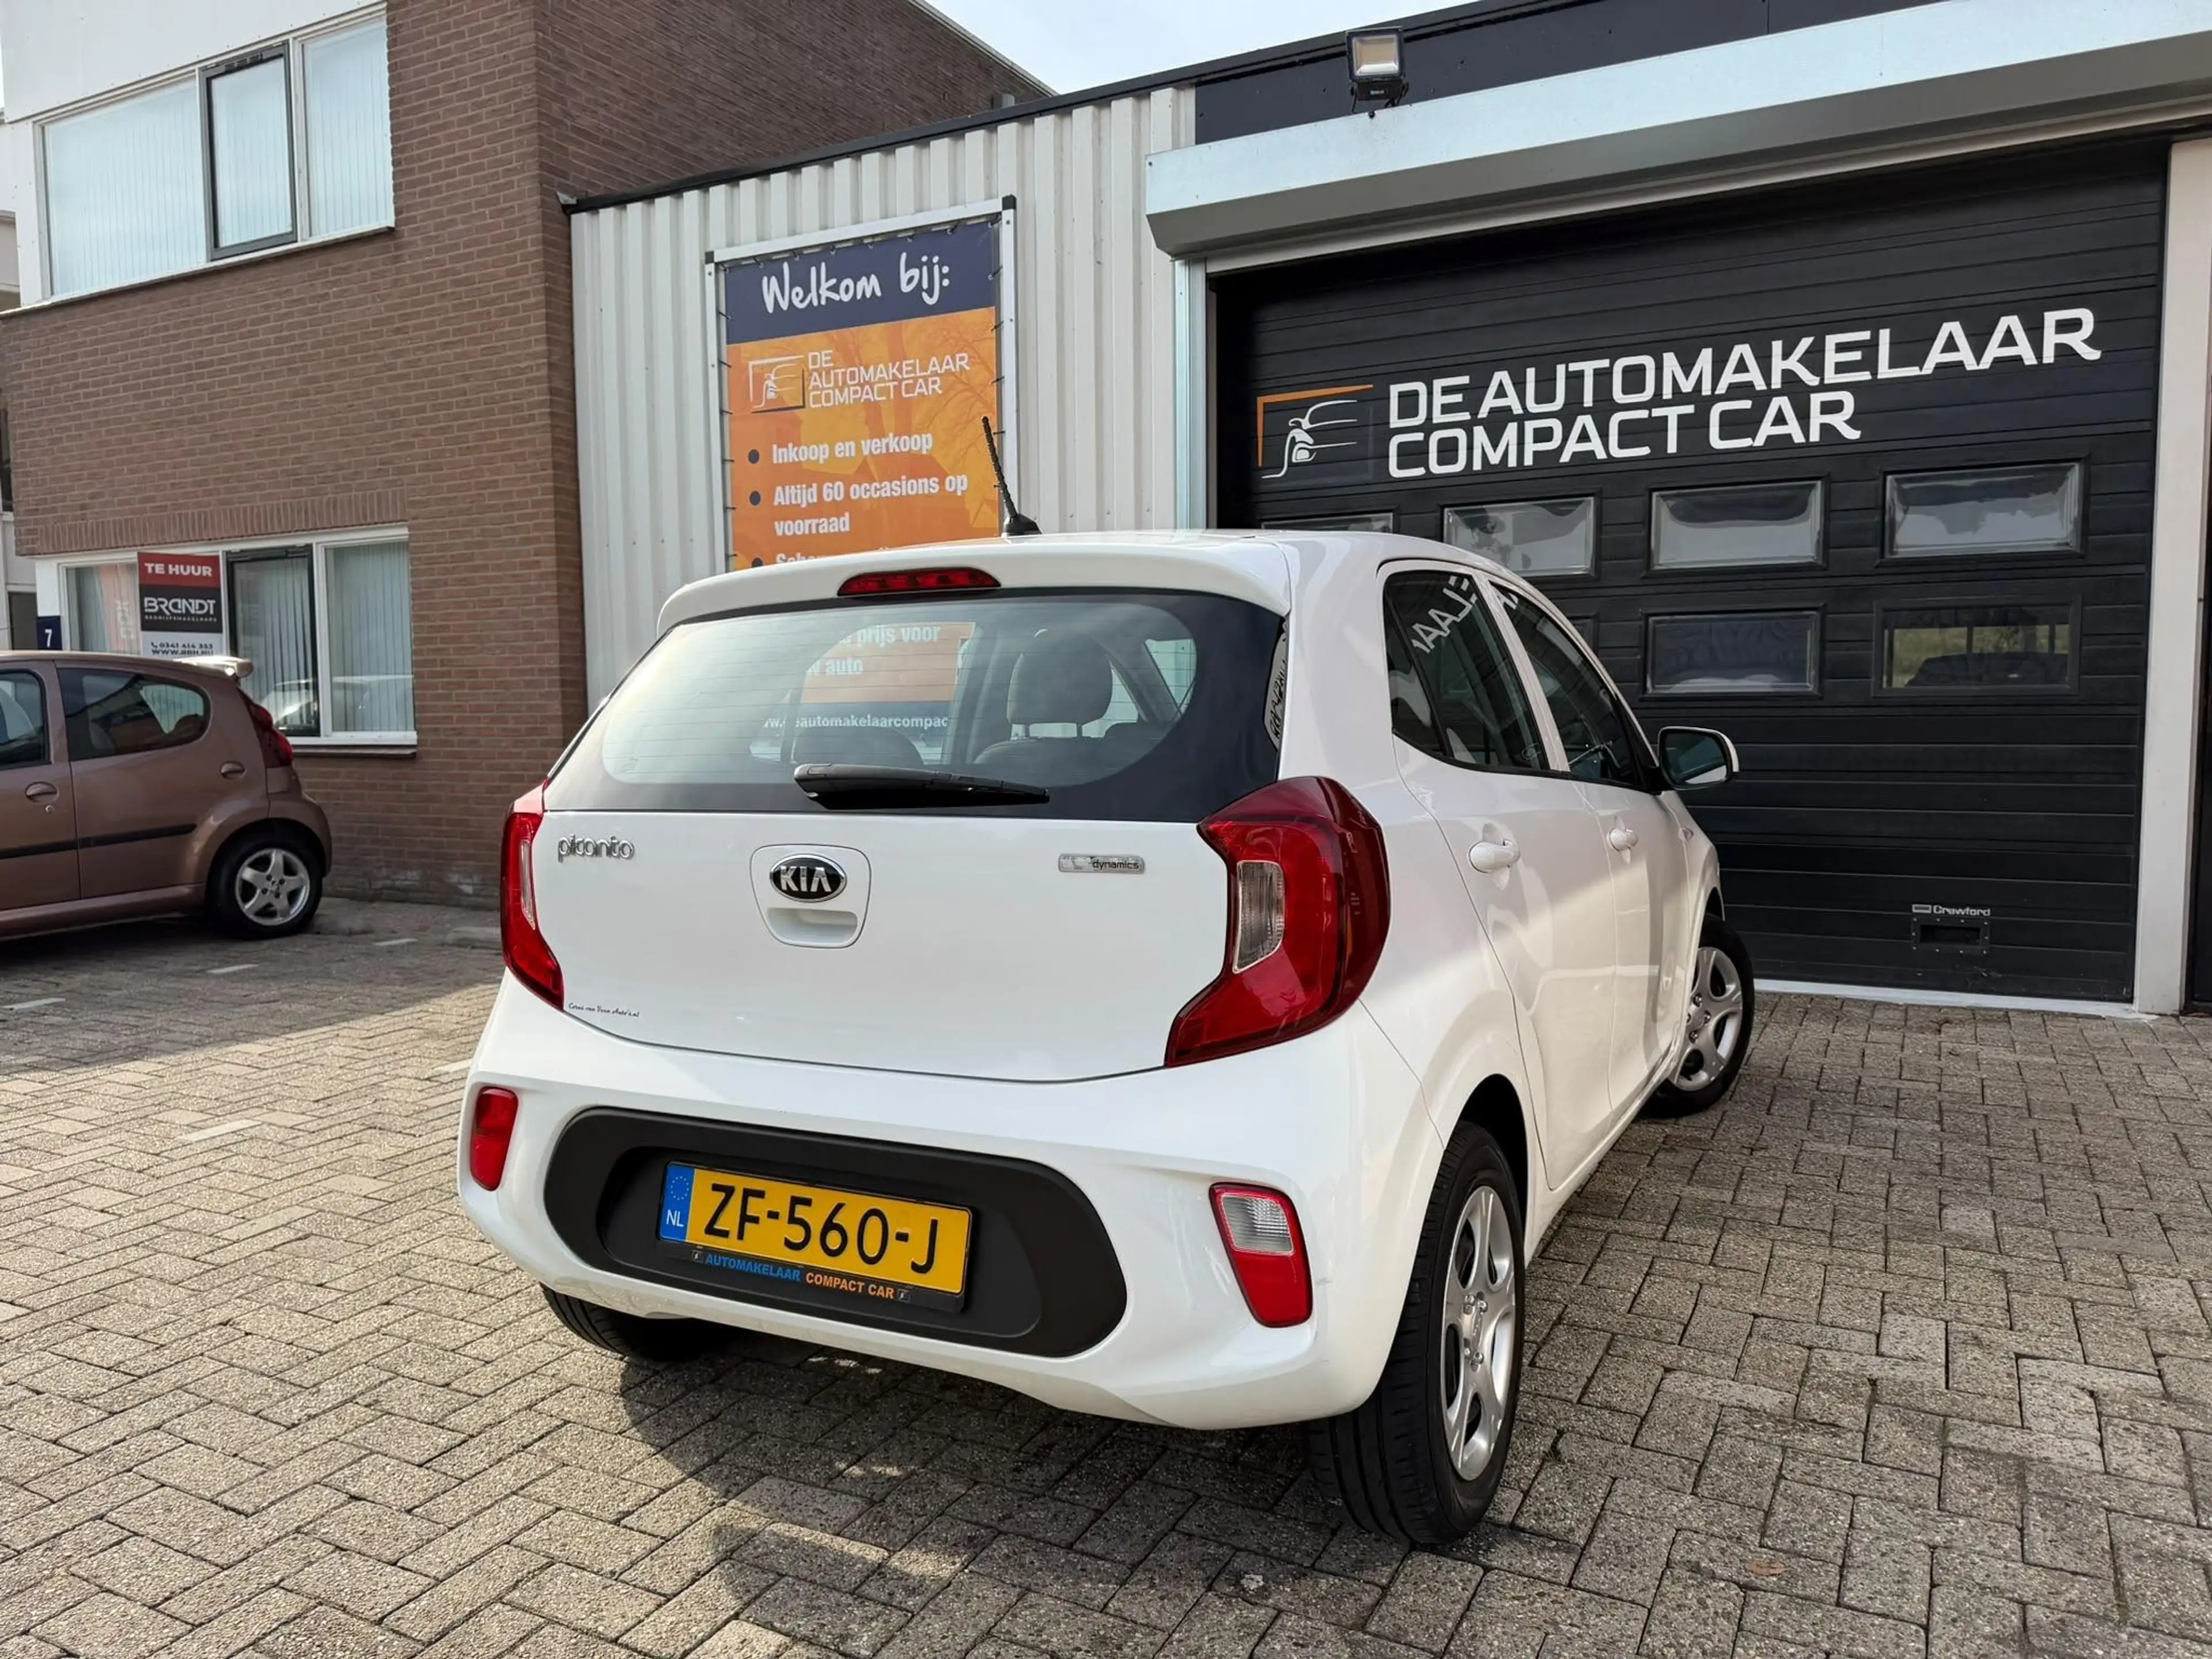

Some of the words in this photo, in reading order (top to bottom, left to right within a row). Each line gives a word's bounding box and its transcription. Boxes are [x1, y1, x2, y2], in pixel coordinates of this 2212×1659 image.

[762, 262, 881, 314] Welkom
[899, 252, 950, 306] bij:
[808, 350, 834, 369] DE
[808, 353, 970, 390] AUTOMAKELAAR
[1388, 375, 1471, 429] DE
[1478, 307, 2102, 419] AUTOMAKELAAR
[809, 381, 897, 409] COMPACT
[902, 377, 942, 399] CAR
[772, 444, 830, 464] Inkoop
[835, 441, 856, 457] en
[861, 432, 933, 456] verkoop
[1388, 404, 1695, 479] COMPACT
[1709, 391, 1862, 450] CAR
[773, 481, 818, 506] Altijd
[822, 482, 845, 501] 60
[849, 475, 940, 499] occasions
[945, 474, 968, 496] op
[774, 513, 850, 536] voorraad
[145, 562, 165, 575] TE
[168, 563, 213, 577] HUUR
[143, 597, 216, 616] BRANDT
[44, 628, 53, 648] 7
[857, 624, 896, 647] prijs
[901, 626, 941, 643] voor
[825, 657, 863, 676] auto
[558, 834, 635, 863] picanto
[779, 865, 832, 892] KIA
[1933, 904, 1991, 916] Crawford
[666, 1209, 684, 1228] NL
[703, 1183, 939, 1275] ZF-560-J
[704, 1253, 801, 1282] AUTOMAKELAAR
[805, 1271, 865, 1294] COMPACT
[867, 1283, 895, 1300] CAR
